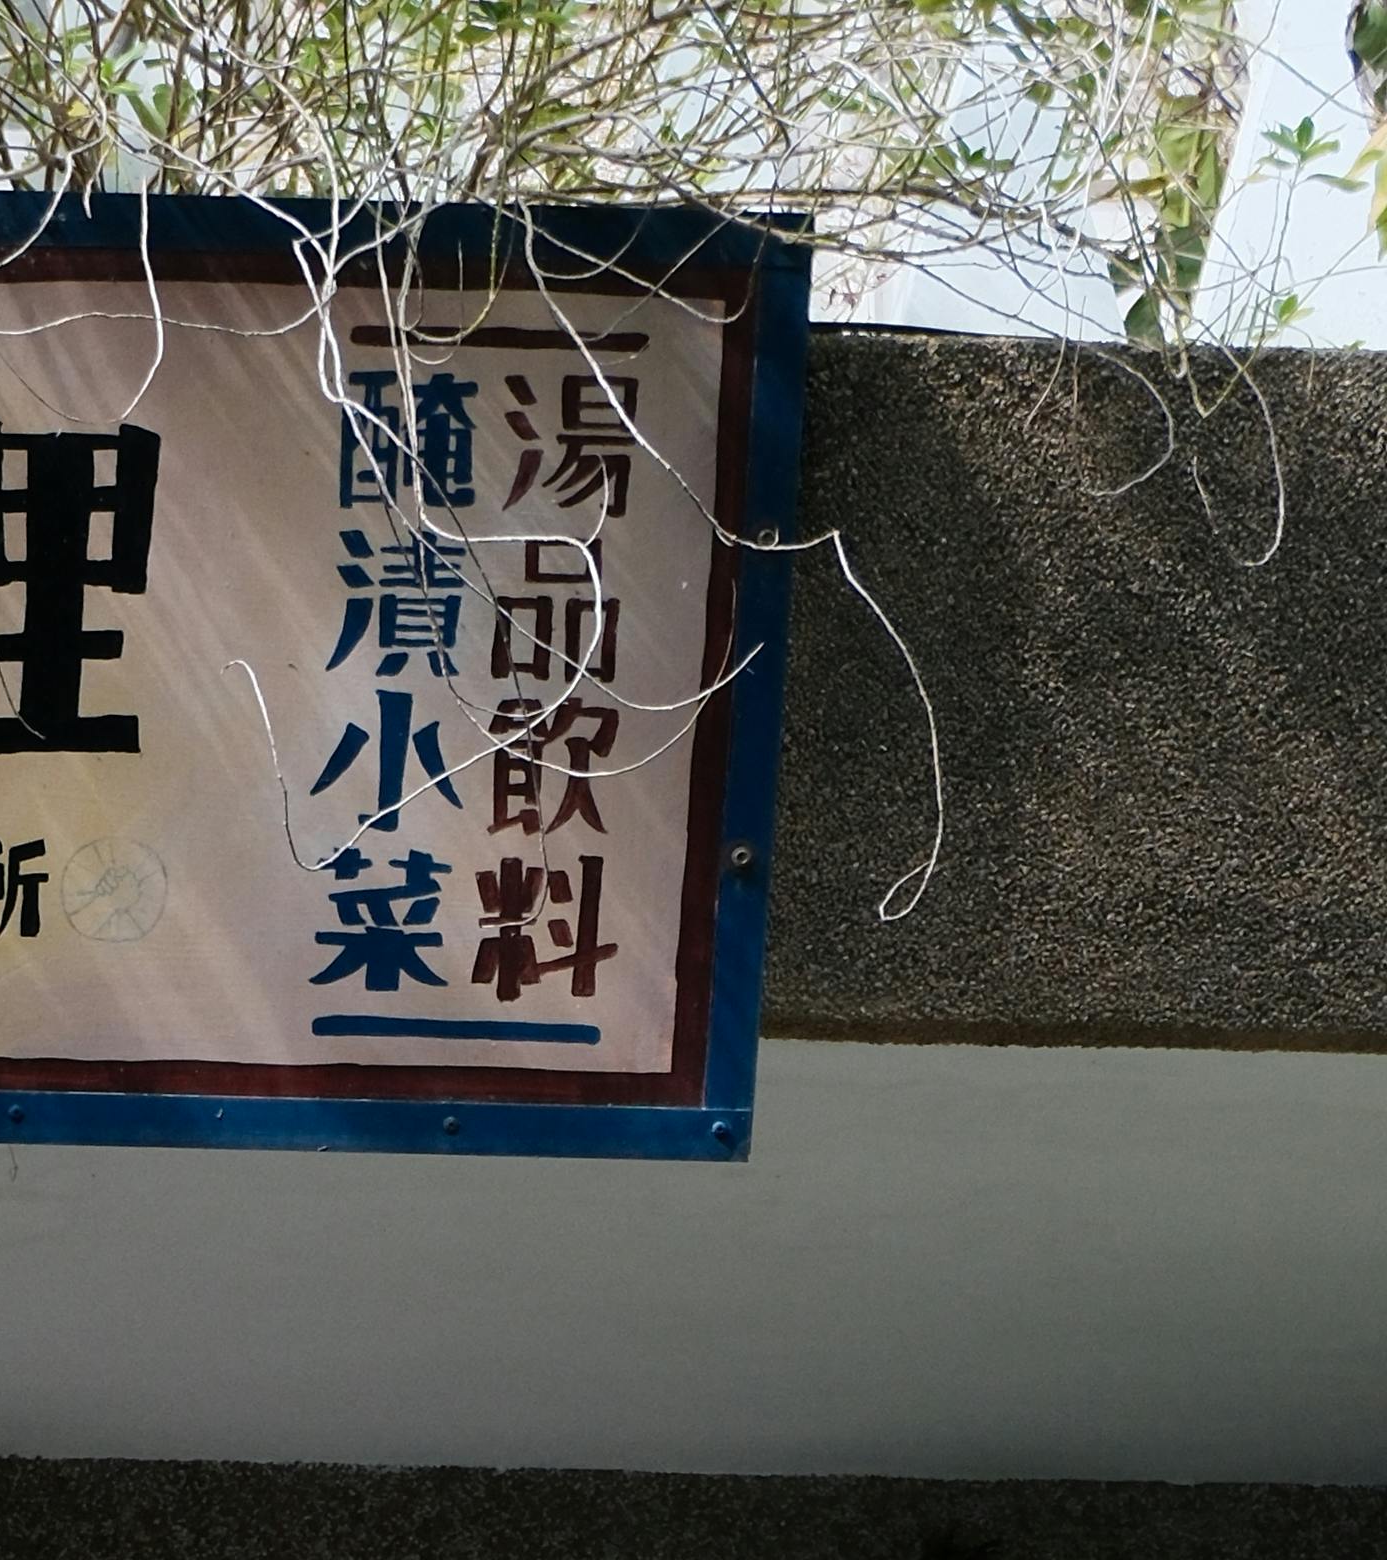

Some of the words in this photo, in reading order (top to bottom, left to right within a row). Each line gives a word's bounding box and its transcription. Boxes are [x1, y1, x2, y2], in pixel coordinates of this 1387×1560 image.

[309, 370, 478, 991] 醃漬小菜
[471, 374, 639, 1003] 湯品飲料
